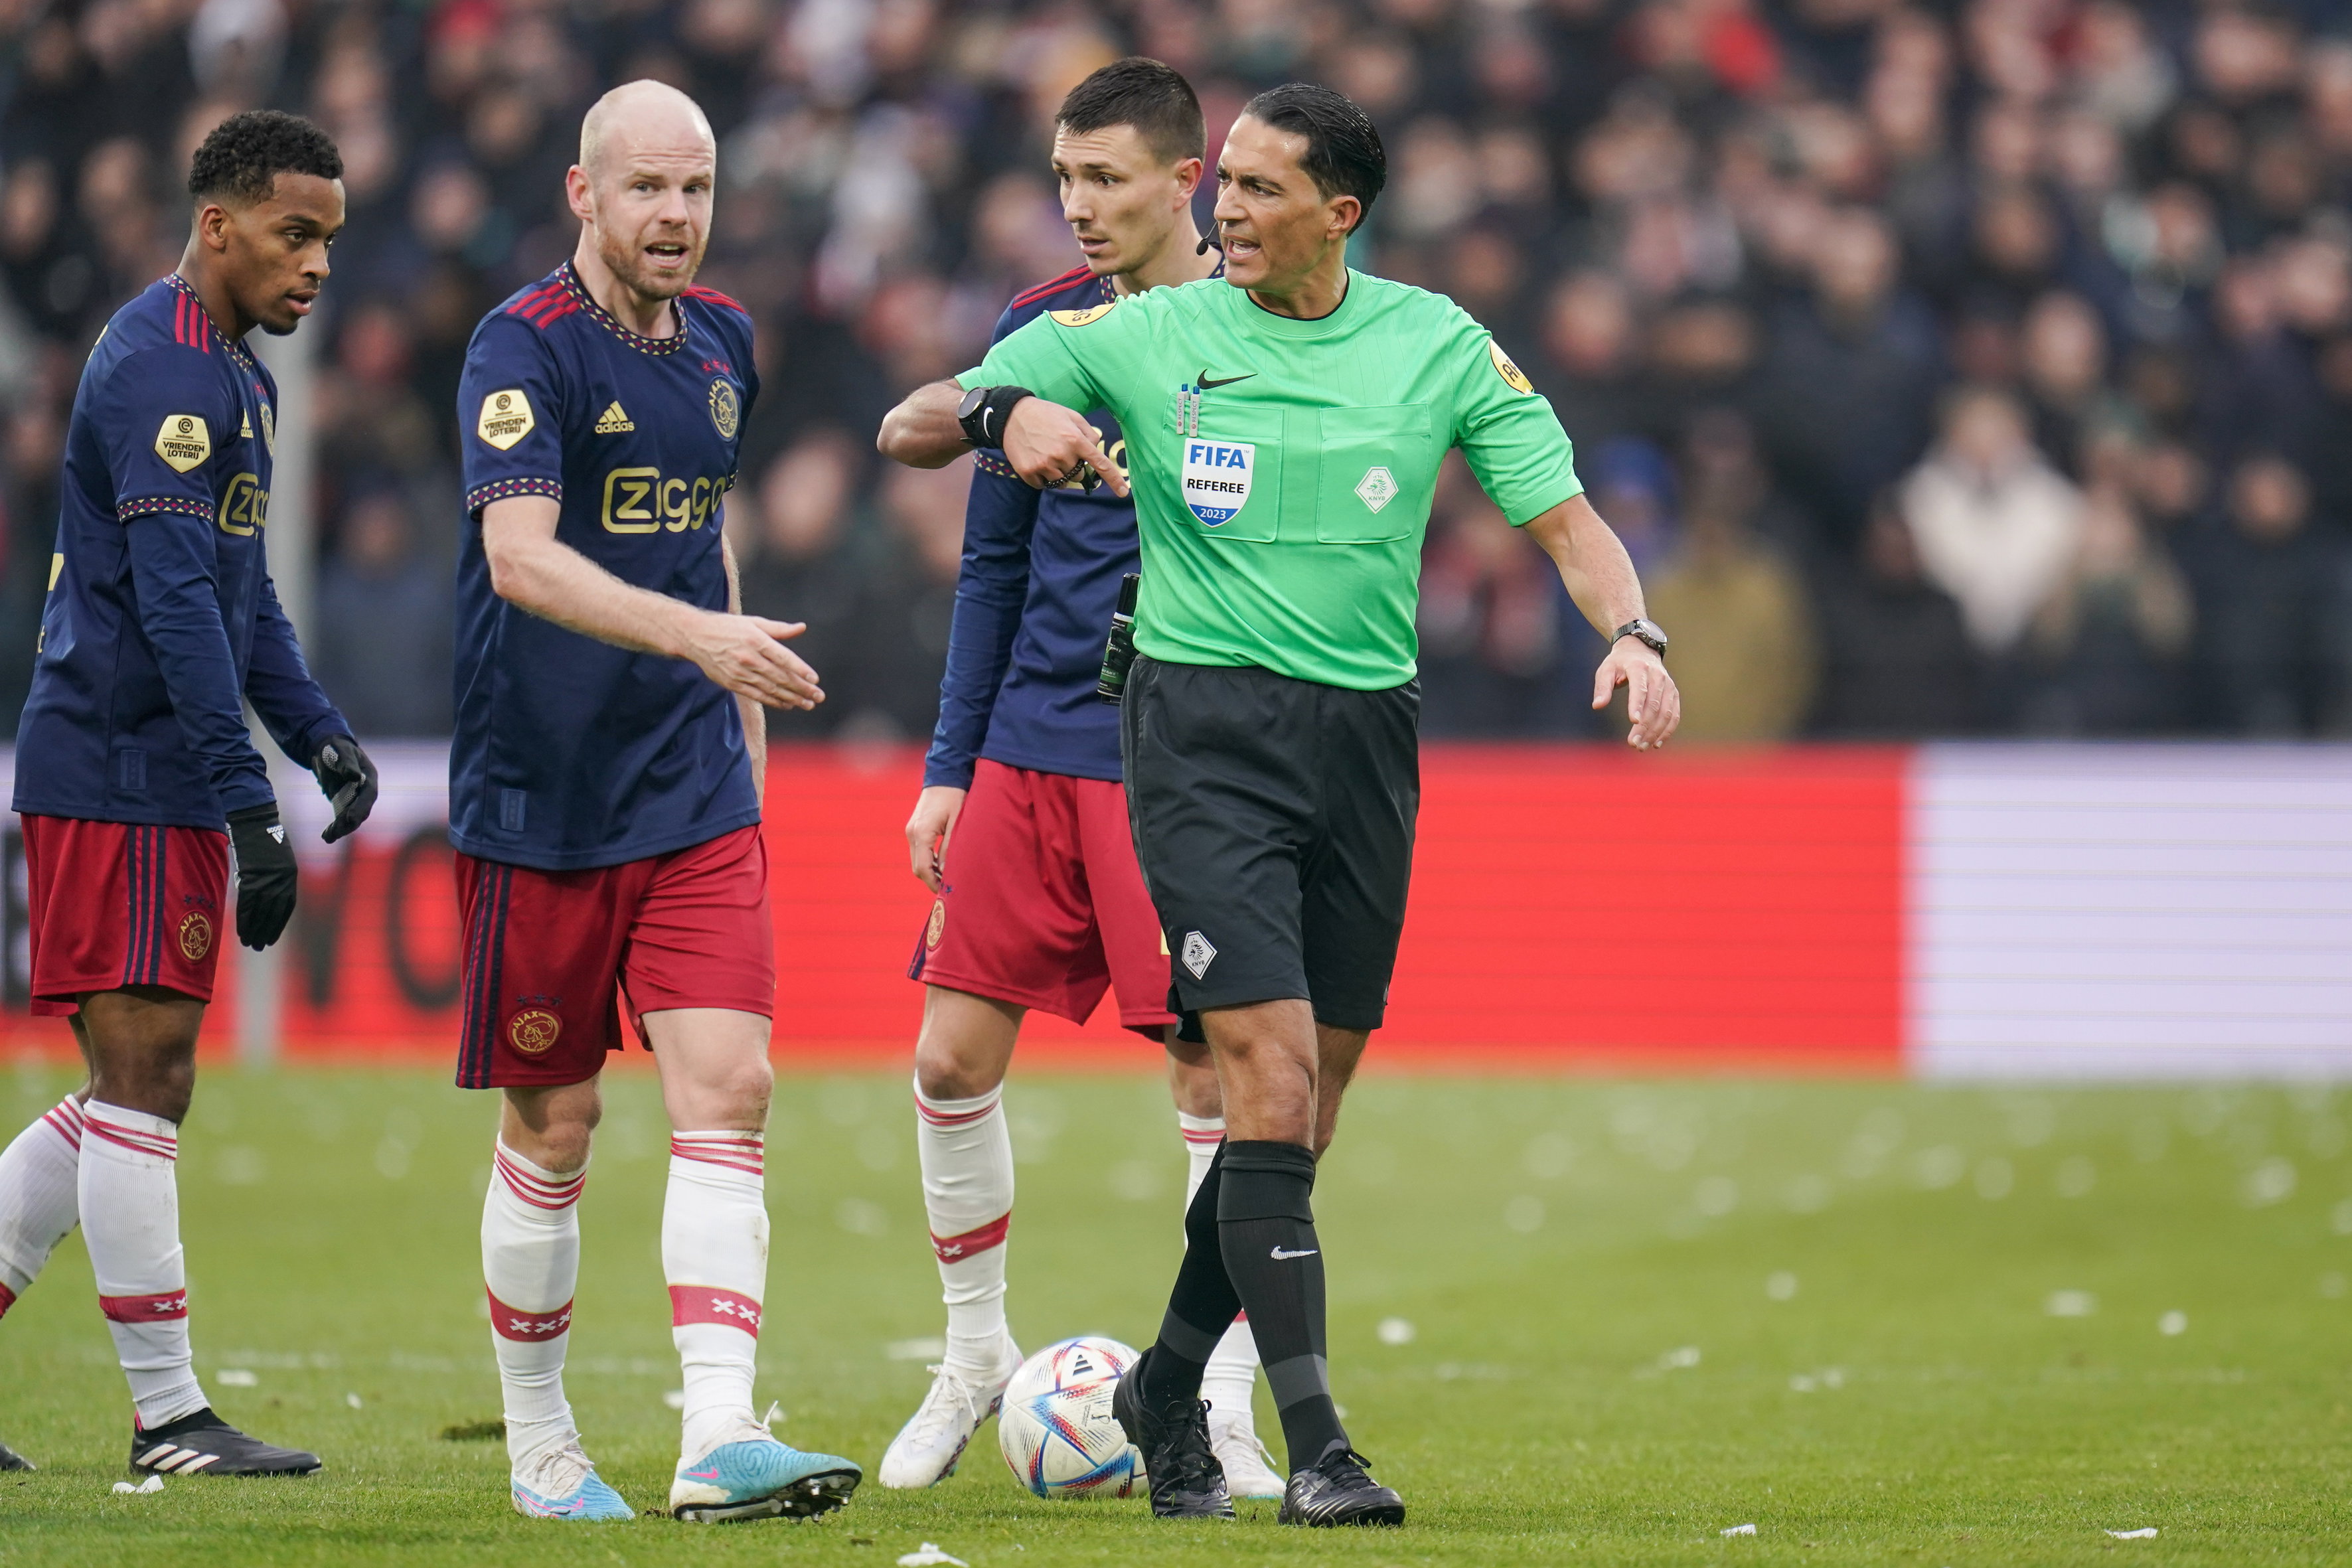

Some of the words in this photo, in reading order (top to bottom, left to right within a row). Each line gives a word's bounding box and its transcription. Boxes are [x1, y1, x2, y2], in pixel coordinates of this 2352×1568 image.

[484, 417, 526, 430] VRIENDEN
[595, 421, 635, 434] adidas
[489, 426, 521, 438] LOTERIJ
[163, 441, 205, 453] VRIENDEN
[167, 449, 199, 460] LOTERIJ
[1190, 444, 1246, 469] FIFA
[1187, 478, 1245, 494] REFEREE
[1200, 507, 1227, 520] 2023
[180, 913, 199, 933] AJAX
[512, 1010, 539, 1030] AJAX
